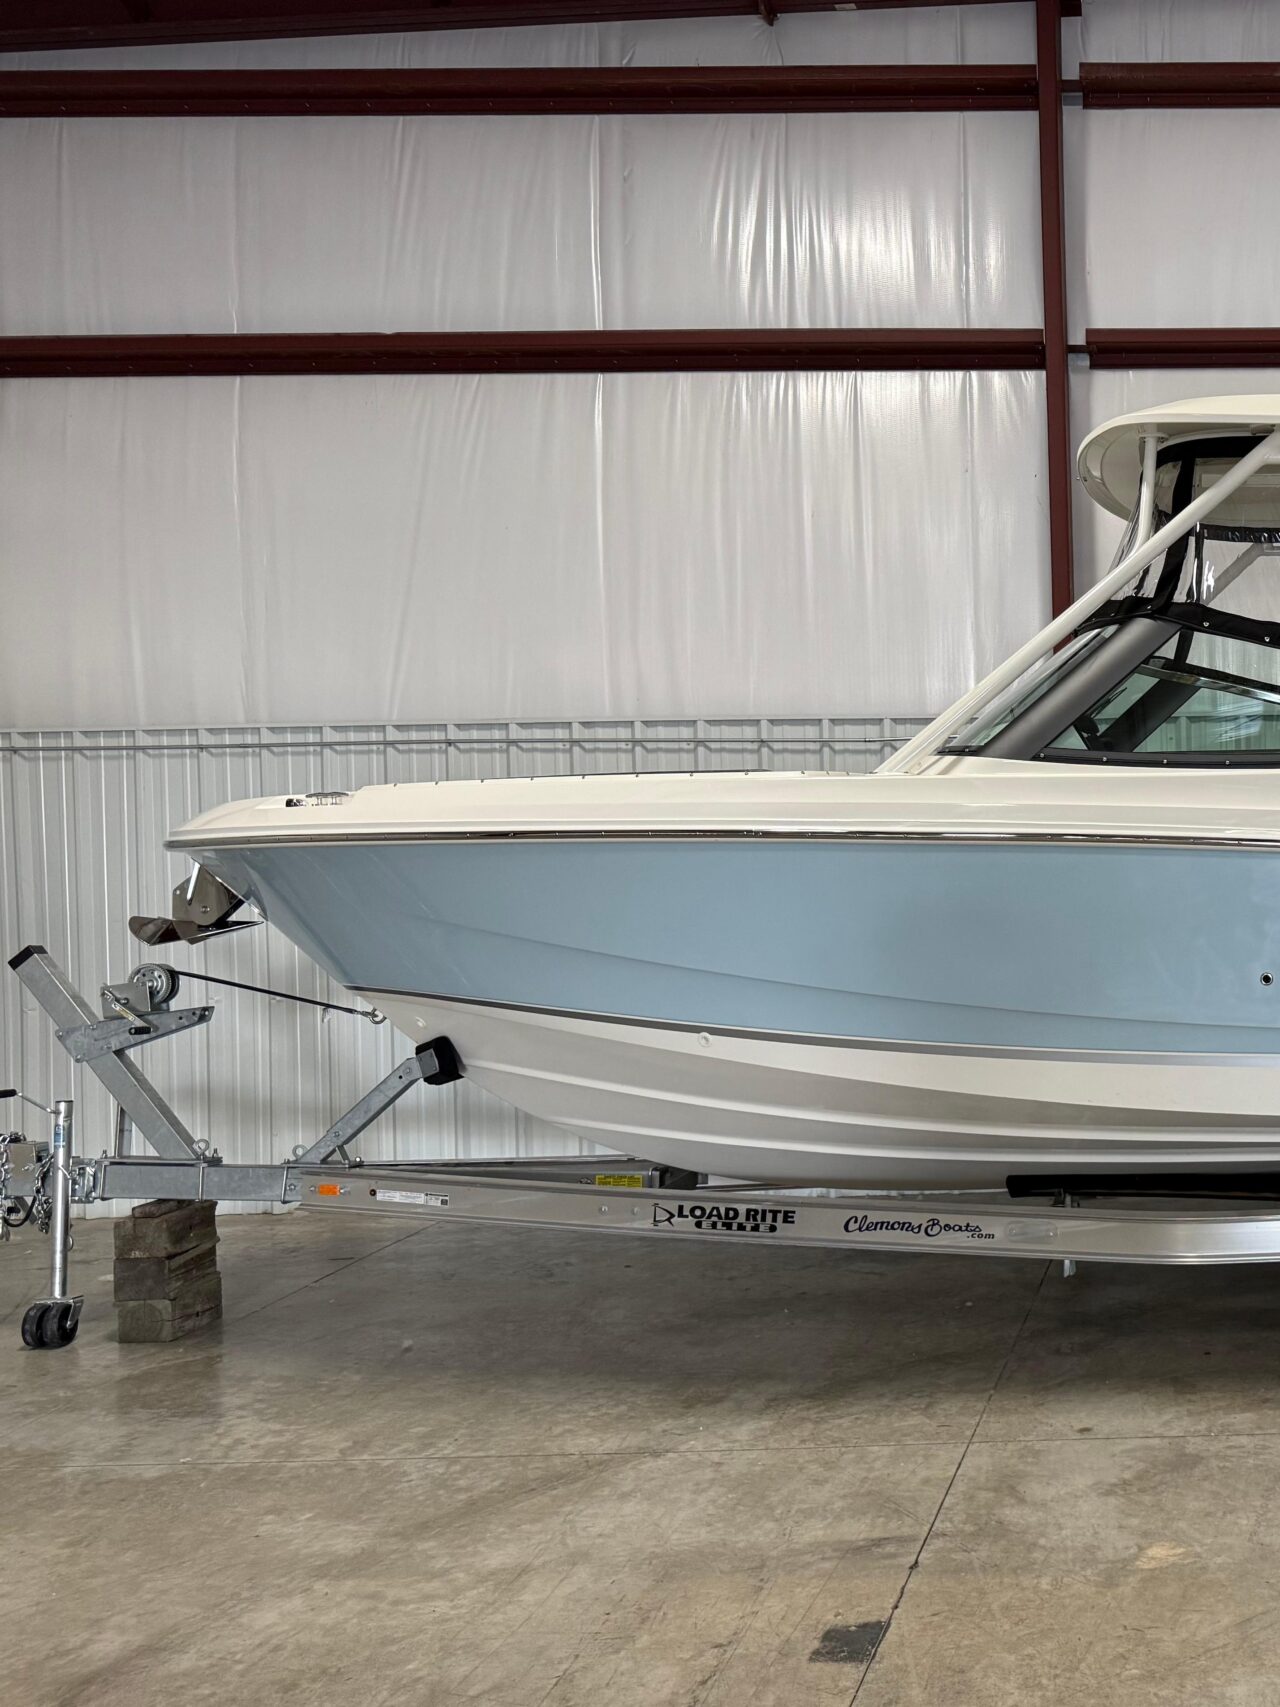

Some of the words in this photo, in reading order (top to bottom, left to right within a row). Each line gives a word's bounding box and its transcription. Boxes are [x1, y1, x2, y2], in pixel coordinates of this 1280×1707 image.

[677, 1204, 740, 1221] LOAD
[745, 1207, 797, 1225] RITE
[700, 1219, 772, 1233] ELITE
